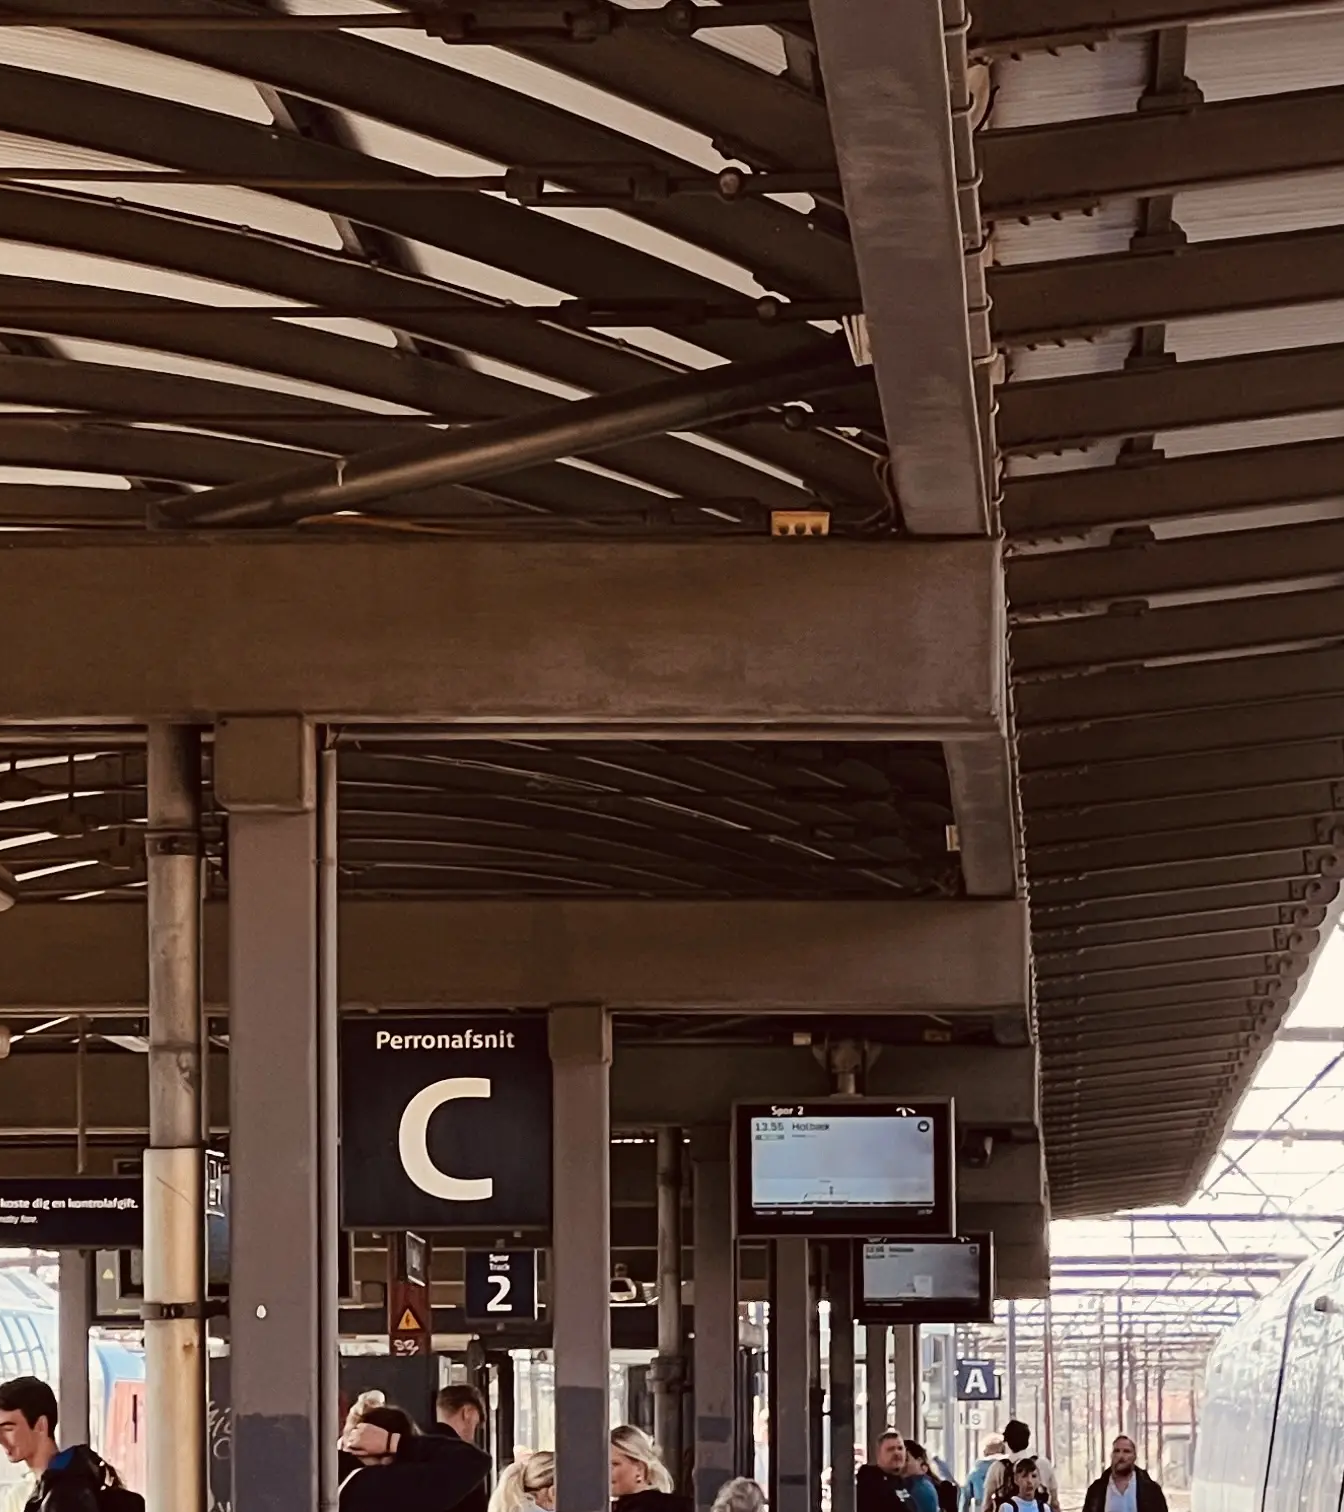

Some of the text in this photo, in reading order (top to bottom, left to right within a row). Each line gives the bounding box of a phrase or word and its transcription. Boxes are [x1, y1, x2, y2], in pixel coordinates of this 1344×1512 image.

[376, 1030, 515, 1050] Perronafsnit
[771, 1106, 804, 1117] Spor 2
[398, 1077, 493, 1201] C
[0, 1197, 30, 1209] koste
[32, 1197, 50, 1210] dig
[51, 1199, 66, 1209] en
[486, 1275, 513, 1312] 2
[964, 1368, 987, 1394] A
